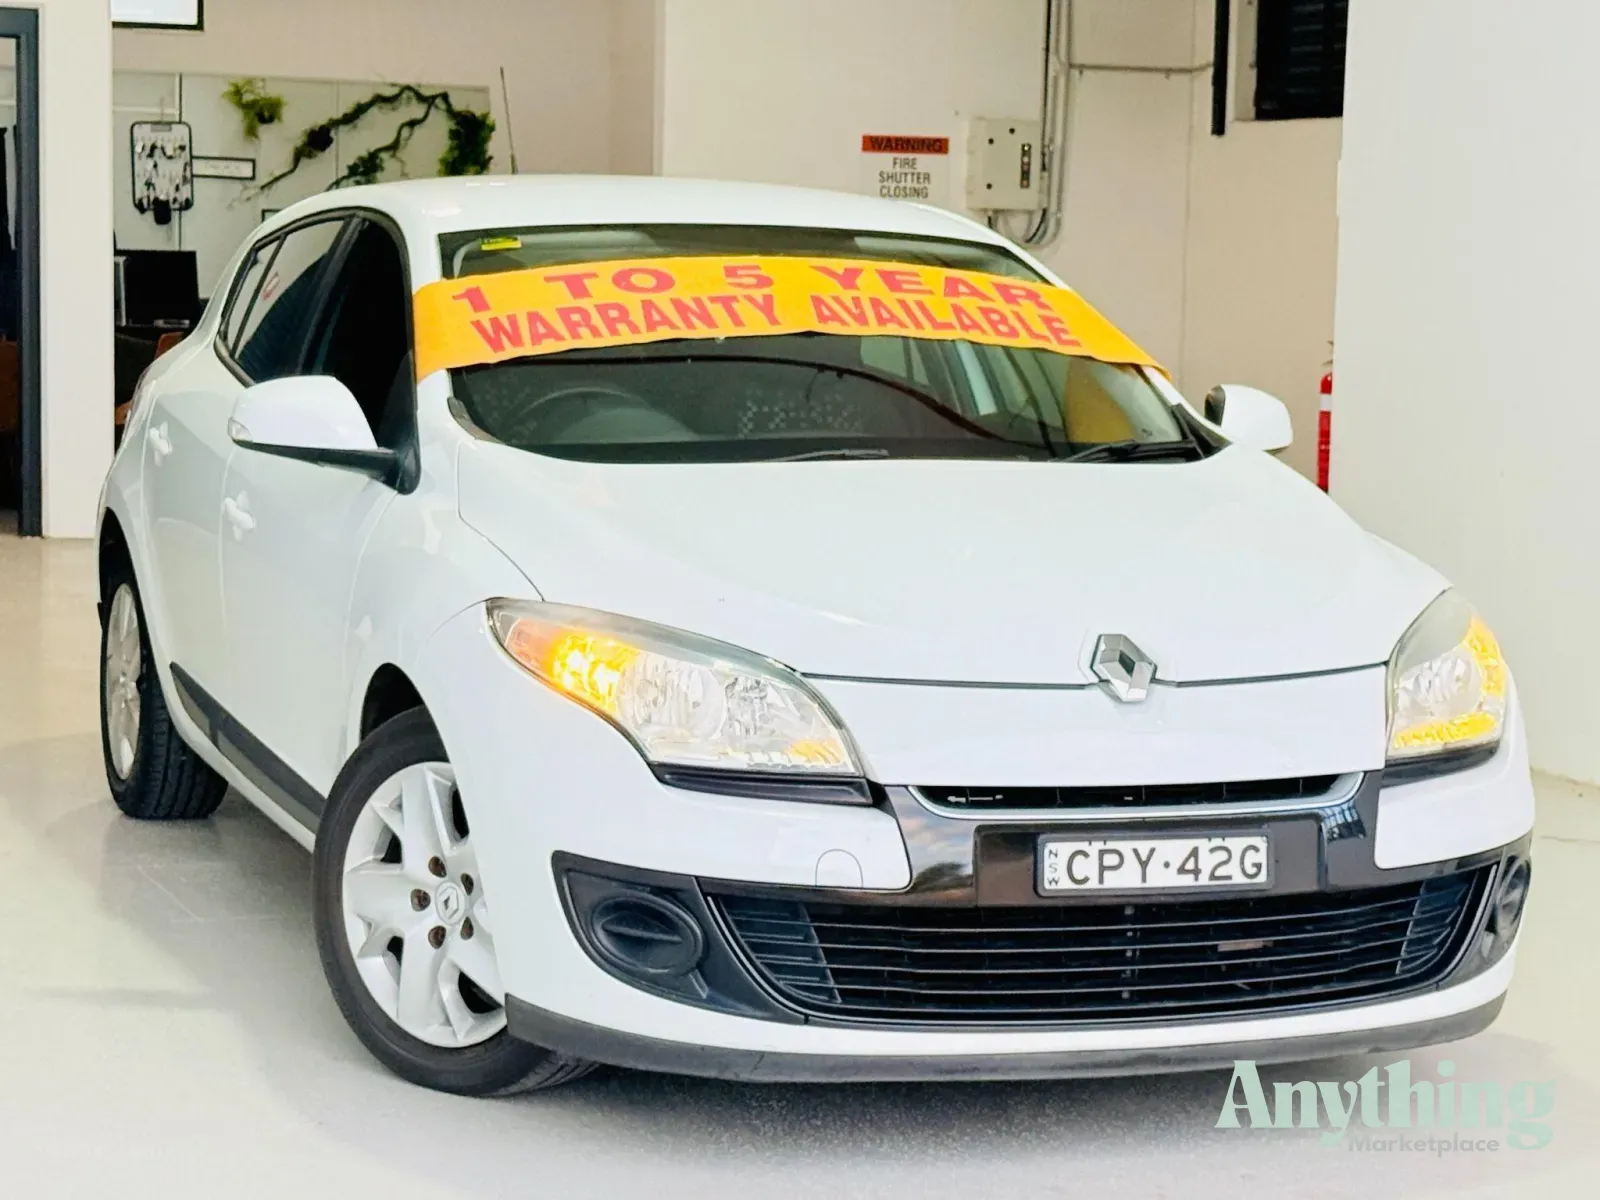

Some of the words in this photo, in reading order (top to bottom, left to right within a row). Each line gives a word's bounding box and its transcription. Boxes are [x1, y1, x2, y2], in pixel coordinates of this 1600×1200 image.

[870, 137, 943, 153] WARNING
[892, 157, 917, 170] FIRE
[878, 171, 931, 185] SHUTTER
[879, 185, 929, 199] CLOSING
[452, 286, 490, 313] 1
[543, 267, 676, 300] TO
[722, 264, 774, 289] 5
[809, 264, 1054, 312] YEAR
[471, 294, 782, 353] WARRANTY
[809, 294, 1083, 347] AVAILABLE
